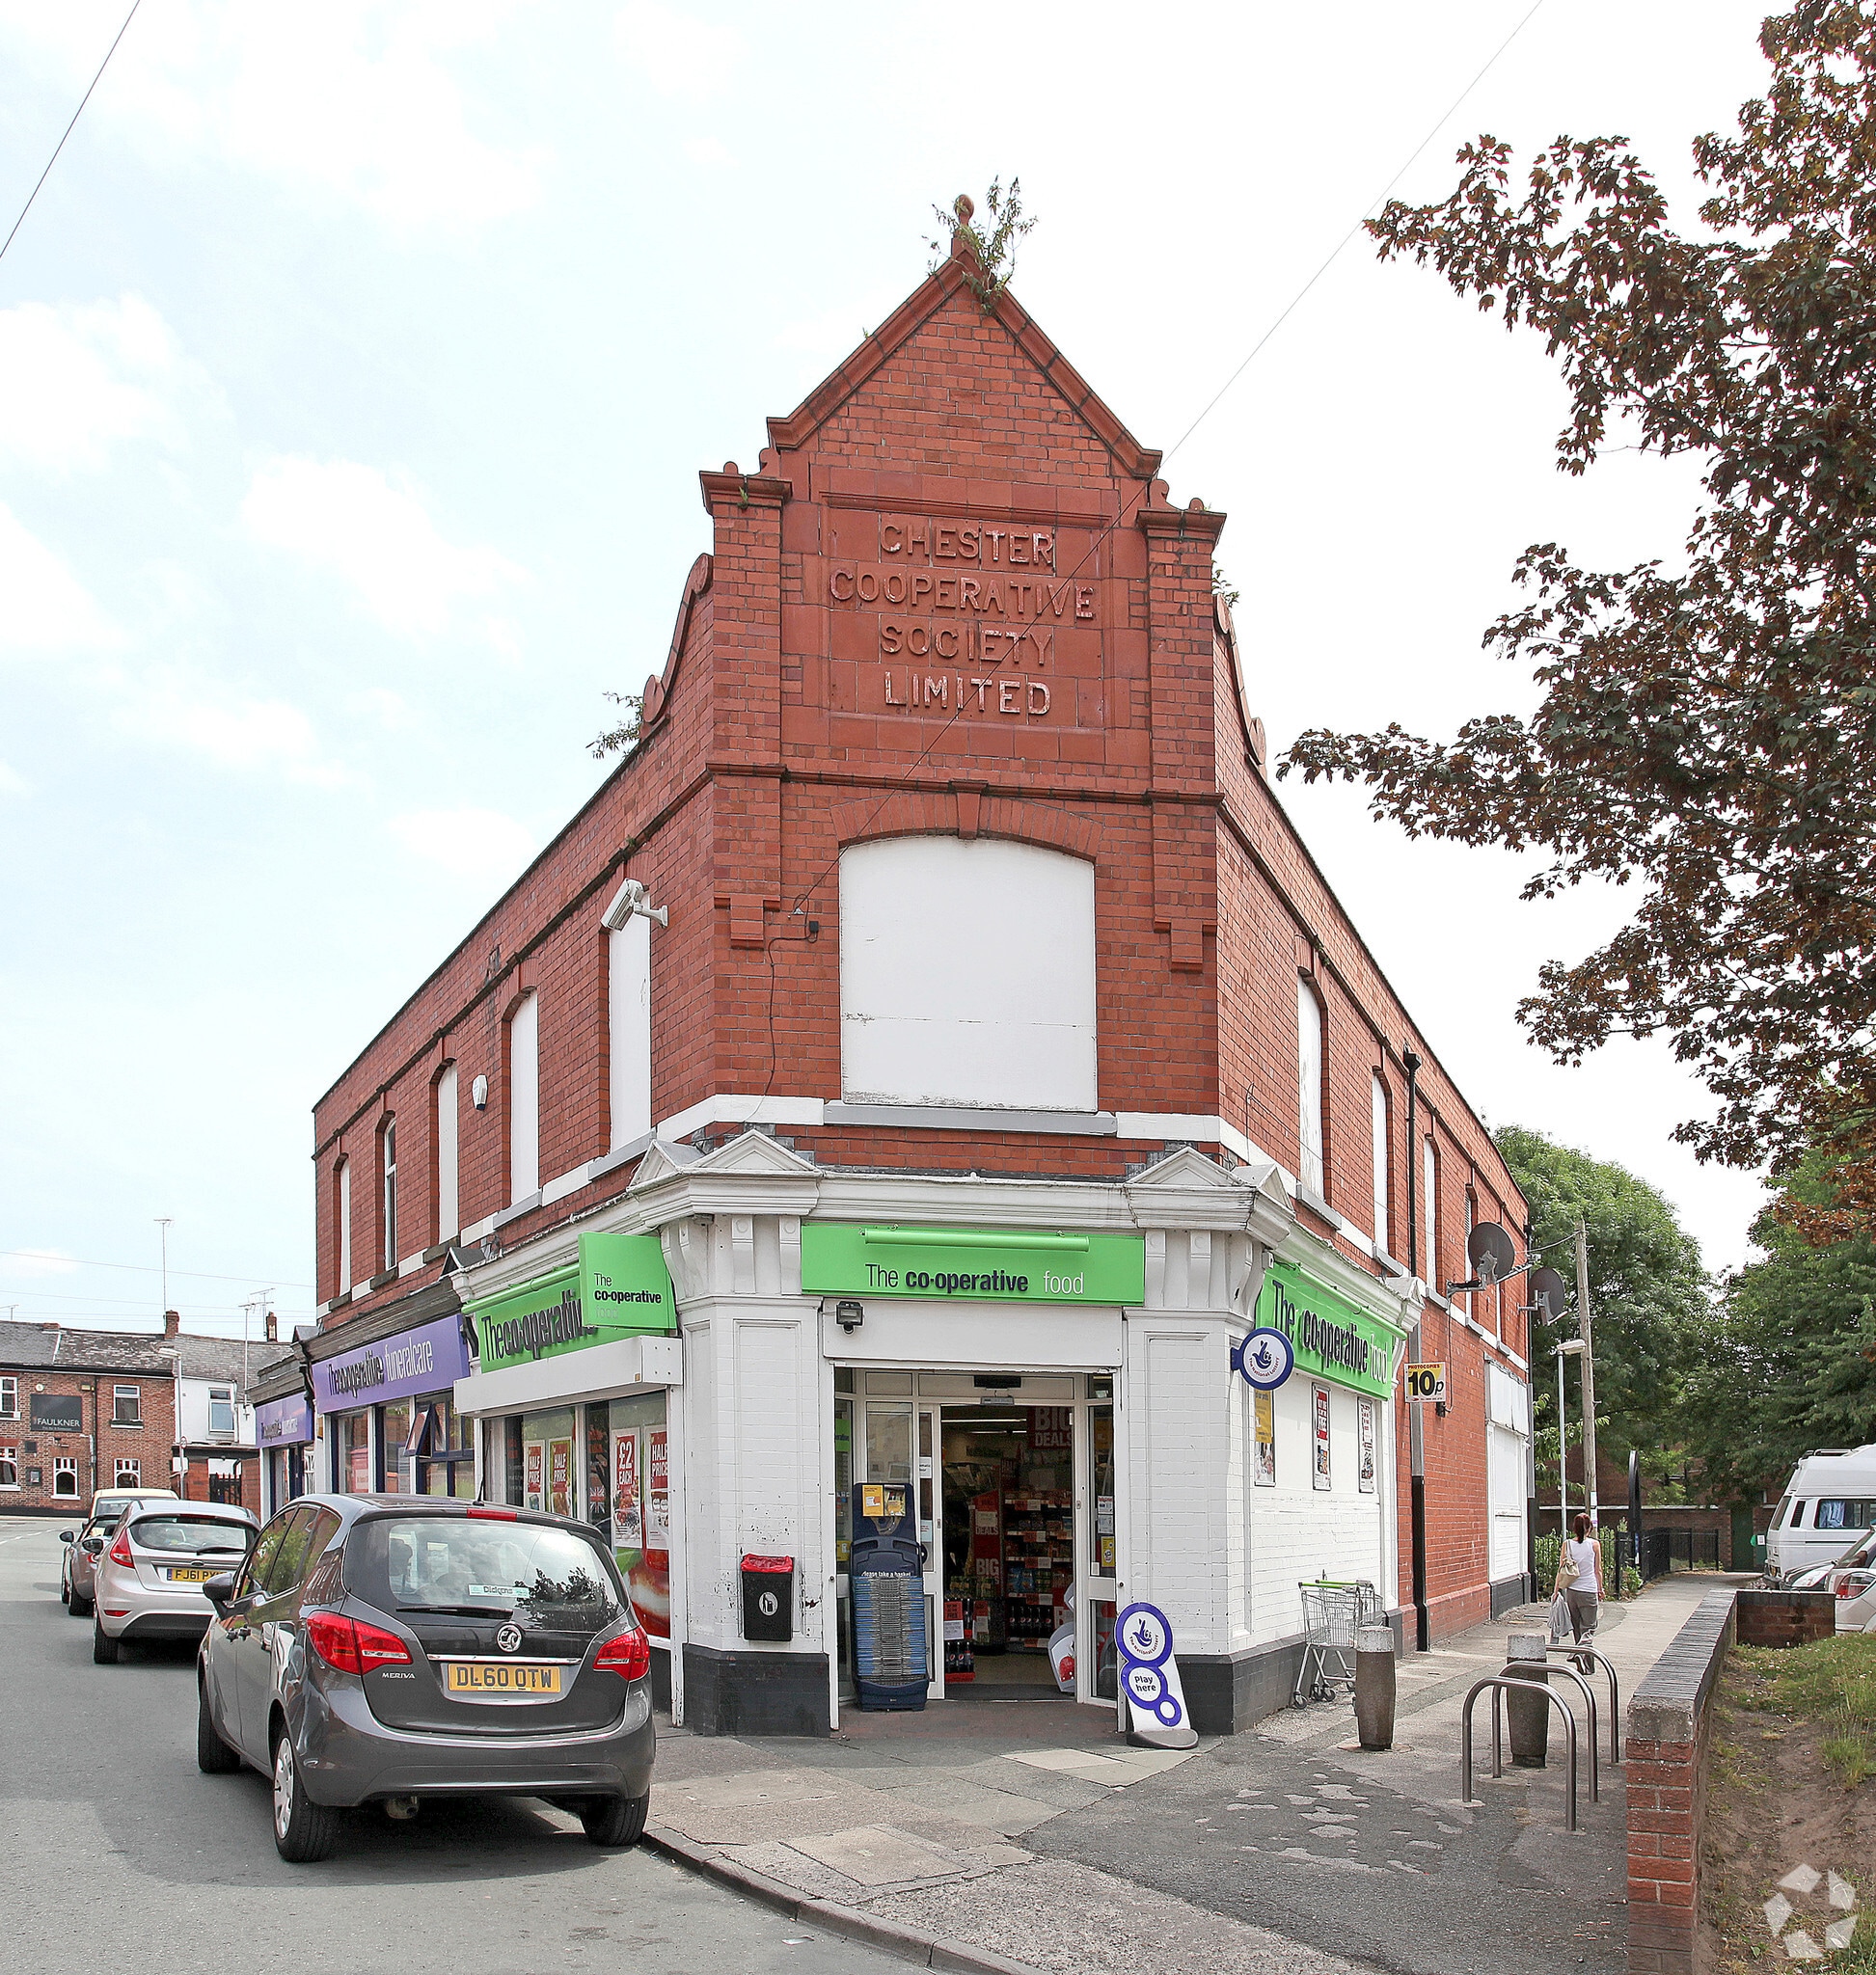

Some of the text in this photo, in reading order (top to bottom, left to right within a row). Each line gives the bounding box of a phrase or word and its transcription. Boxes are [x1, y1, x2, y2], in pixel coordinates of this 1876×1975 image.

[880, 524, 1054, 564] CHESTER
[829, 567, 1095, 619] COOPERATIVE
[880, 626, 1053, 665] SOCIETY
[884, 671, 1051, 716] LIMITED
[594, 1272, 612, 1287] The
[865, 1263, 1085, 1294] The co-operative food
[594, 1289, 662, 1304] co-operative
[595, 1305, 619, 1319] food
[503, 1288, 597, 1360] co-operativ
[1272, 1279, 1295, 1343] The
[1370, 1333, 1388, 1385] food
[385, 1337, 433, 1382] funeralcare
[37, 1418, 80, 1427] FAULKNER
[554, 1452, 567, 1468] HALF
[619, 1441, 633, 1469] £2
[554, 1469, 567, 1483] PRICE
[618, 1470, 633, 1484] EACH
[176, 1569, 200, 1581] FJ61
[976, 1558, 999, 1576] BIG
[1133, 1644, 1153, 1655] National
[456, 1666, 552, 1688] DL60 OTW
[1134, 1676, 1154, 1685] Play
